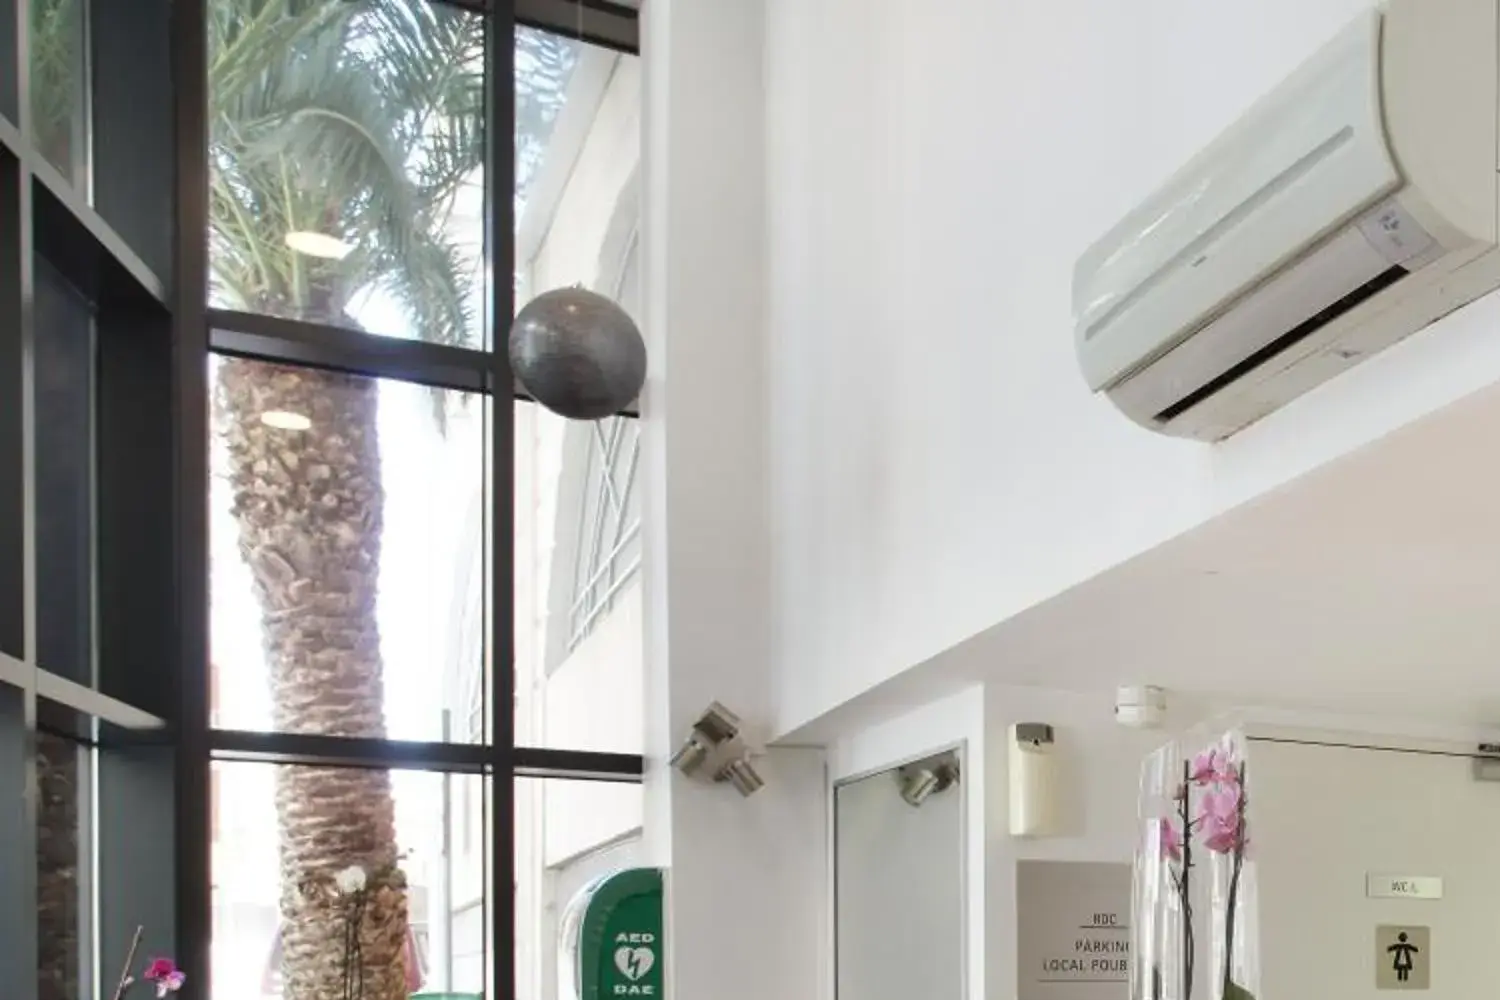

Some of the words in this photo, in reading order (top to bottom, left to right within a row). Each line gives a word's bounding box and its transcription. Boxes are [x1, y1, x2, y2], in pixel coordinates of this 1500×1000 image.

[615, 932, 655, 943] AED
[1074, 940, 1130, 953] PARKIN
[1042, 959, 1085, 972] LOCAL
[1091, 959, 1128, 972] POUB
[613, 984, 656, 995] DAE
